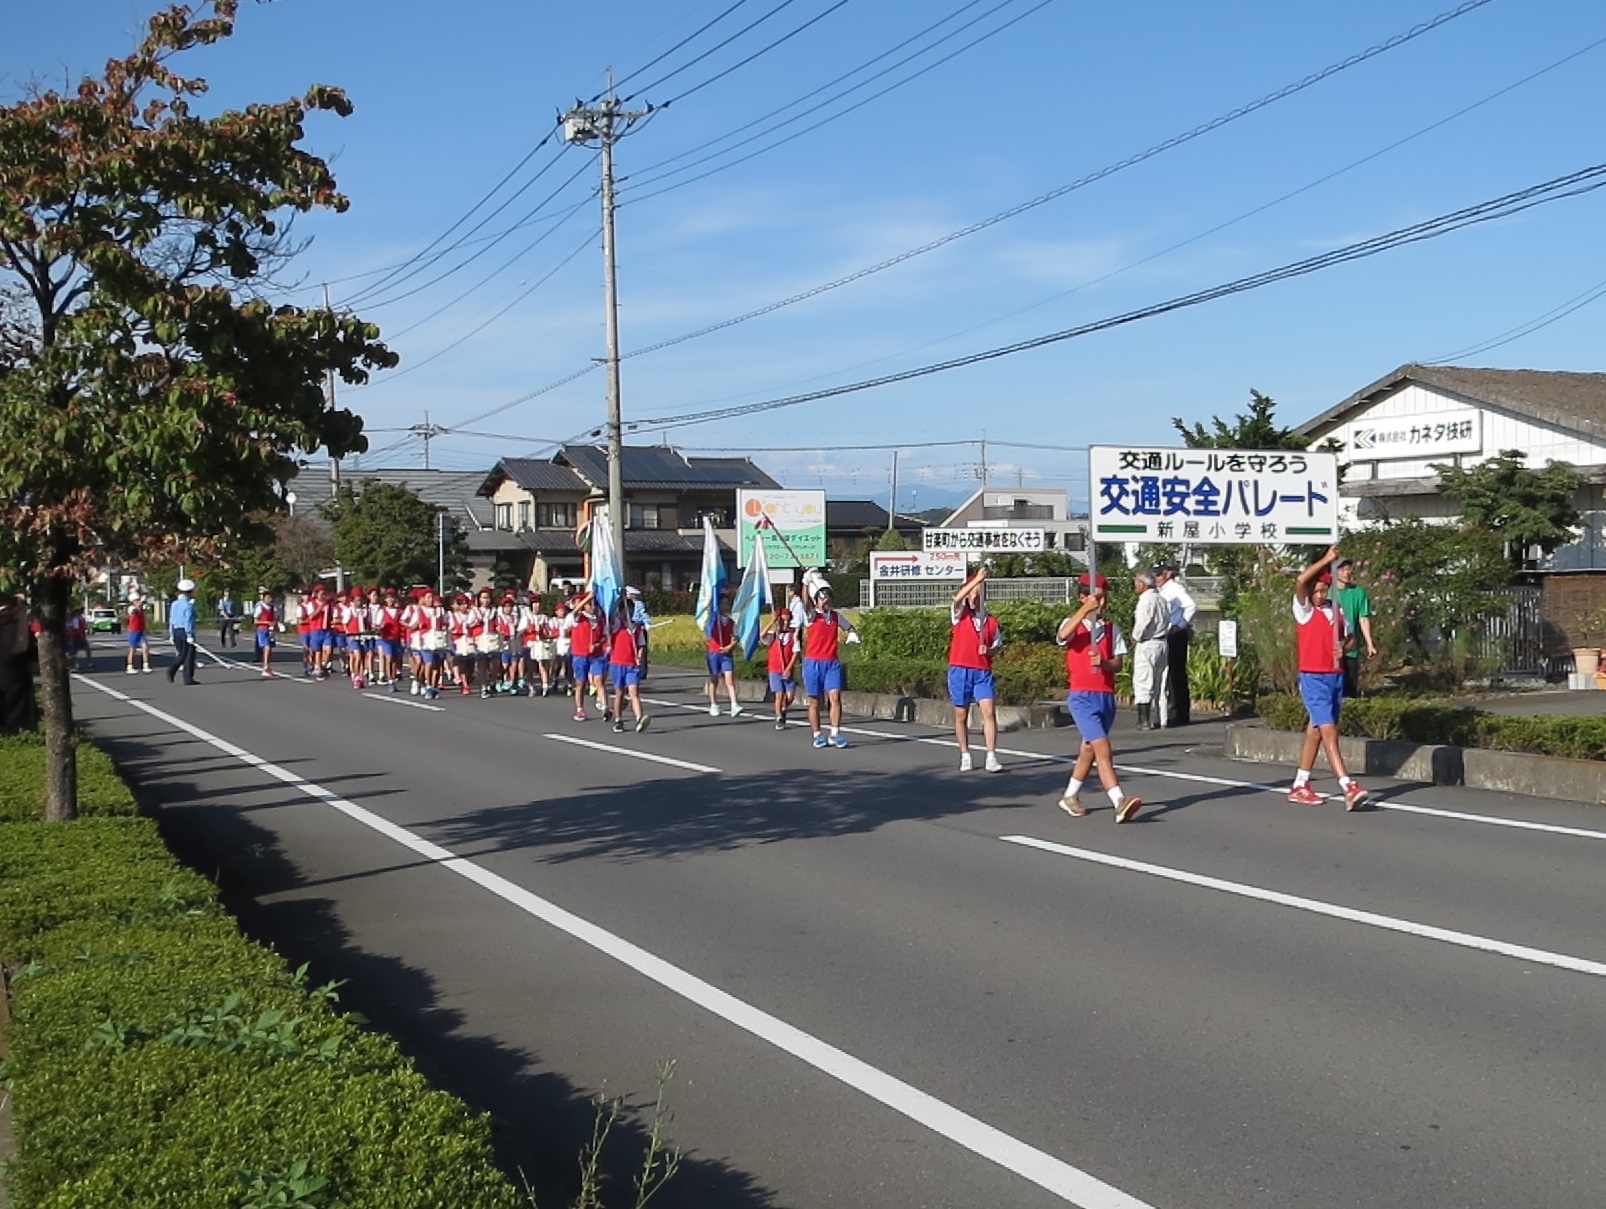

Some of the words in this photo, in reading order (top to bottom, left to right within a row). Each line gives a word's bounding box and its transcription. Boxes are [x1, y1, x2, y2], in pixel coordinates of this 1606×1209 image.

[1409, 420, 1473, 444] カネタ技研
[1119, 451, 1308, 474] 交通ルールを守ろう
[1100, 474, 1328, 517] 交通安全パレード
[926, 531, 1041, 548] 甘楽町から交通事故をなくそう
[1157, 521, 1278, 539] 新屋小学校
[925, 564, 965, 577] センター
